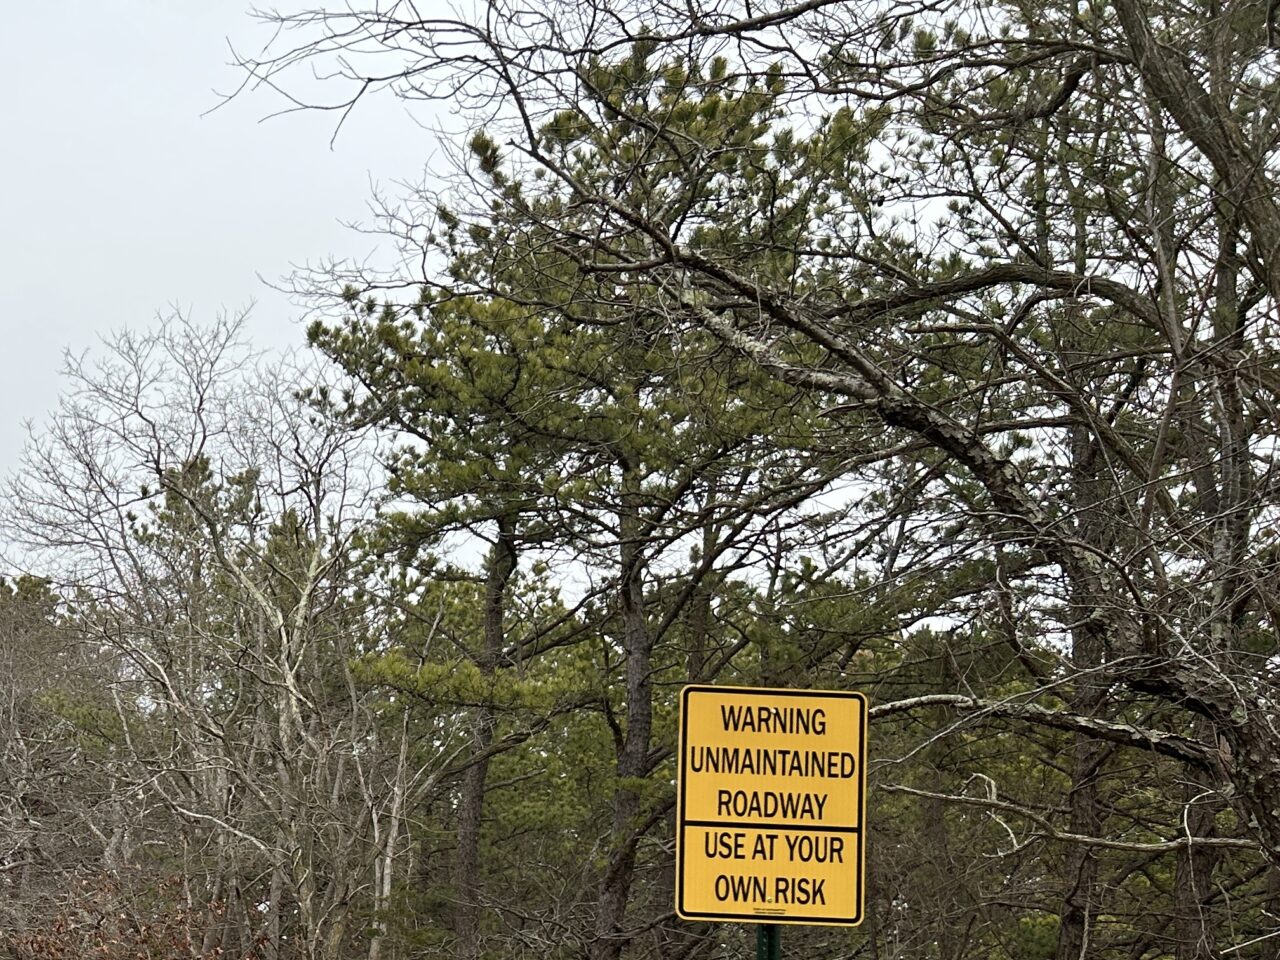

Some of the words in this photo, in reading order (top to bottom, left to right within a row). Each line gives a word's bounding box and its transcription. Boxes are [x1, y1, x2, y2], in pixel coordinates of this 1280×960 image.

[720, 704, 827, 736] WARNING
[690, 746, 855, 779] UNMAINTAINED
[717, 789, 828, 821] ROADWAY
[704, 831, 746, 860] USE
[751, 833, 779, 861] AT
[785, 835, 844, 864] YOUR
[714, 874, 767, 903] OWN
[774, 877, 826, 906] RISK
